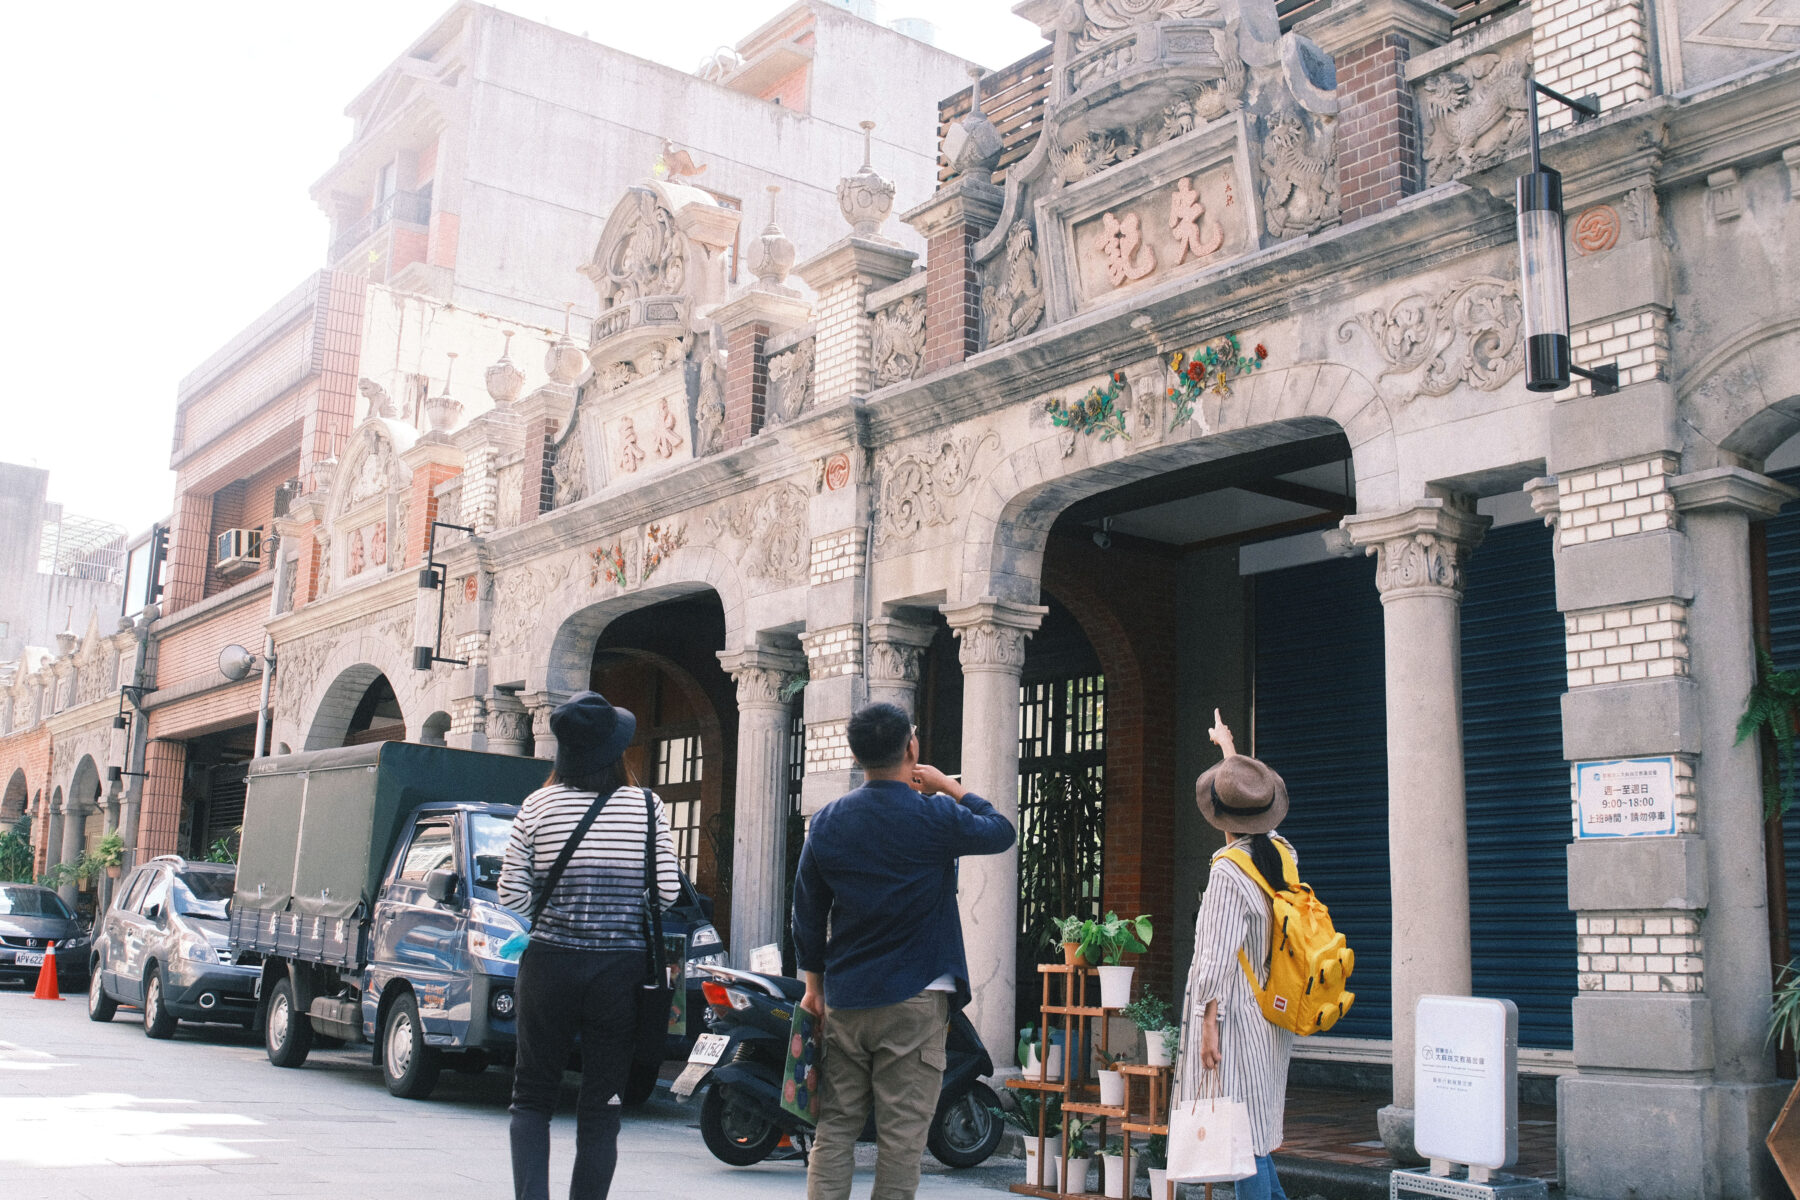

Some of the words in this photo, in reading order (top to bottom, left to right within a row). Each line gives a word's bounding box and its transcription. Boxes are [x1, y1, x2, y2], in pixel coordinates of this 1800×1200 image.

[1604, 784, 1649, 796] 週一至週日
[1602, 798, 1654, 809] 9:00~18:00
[16, 955, 44, 964] APV-622
